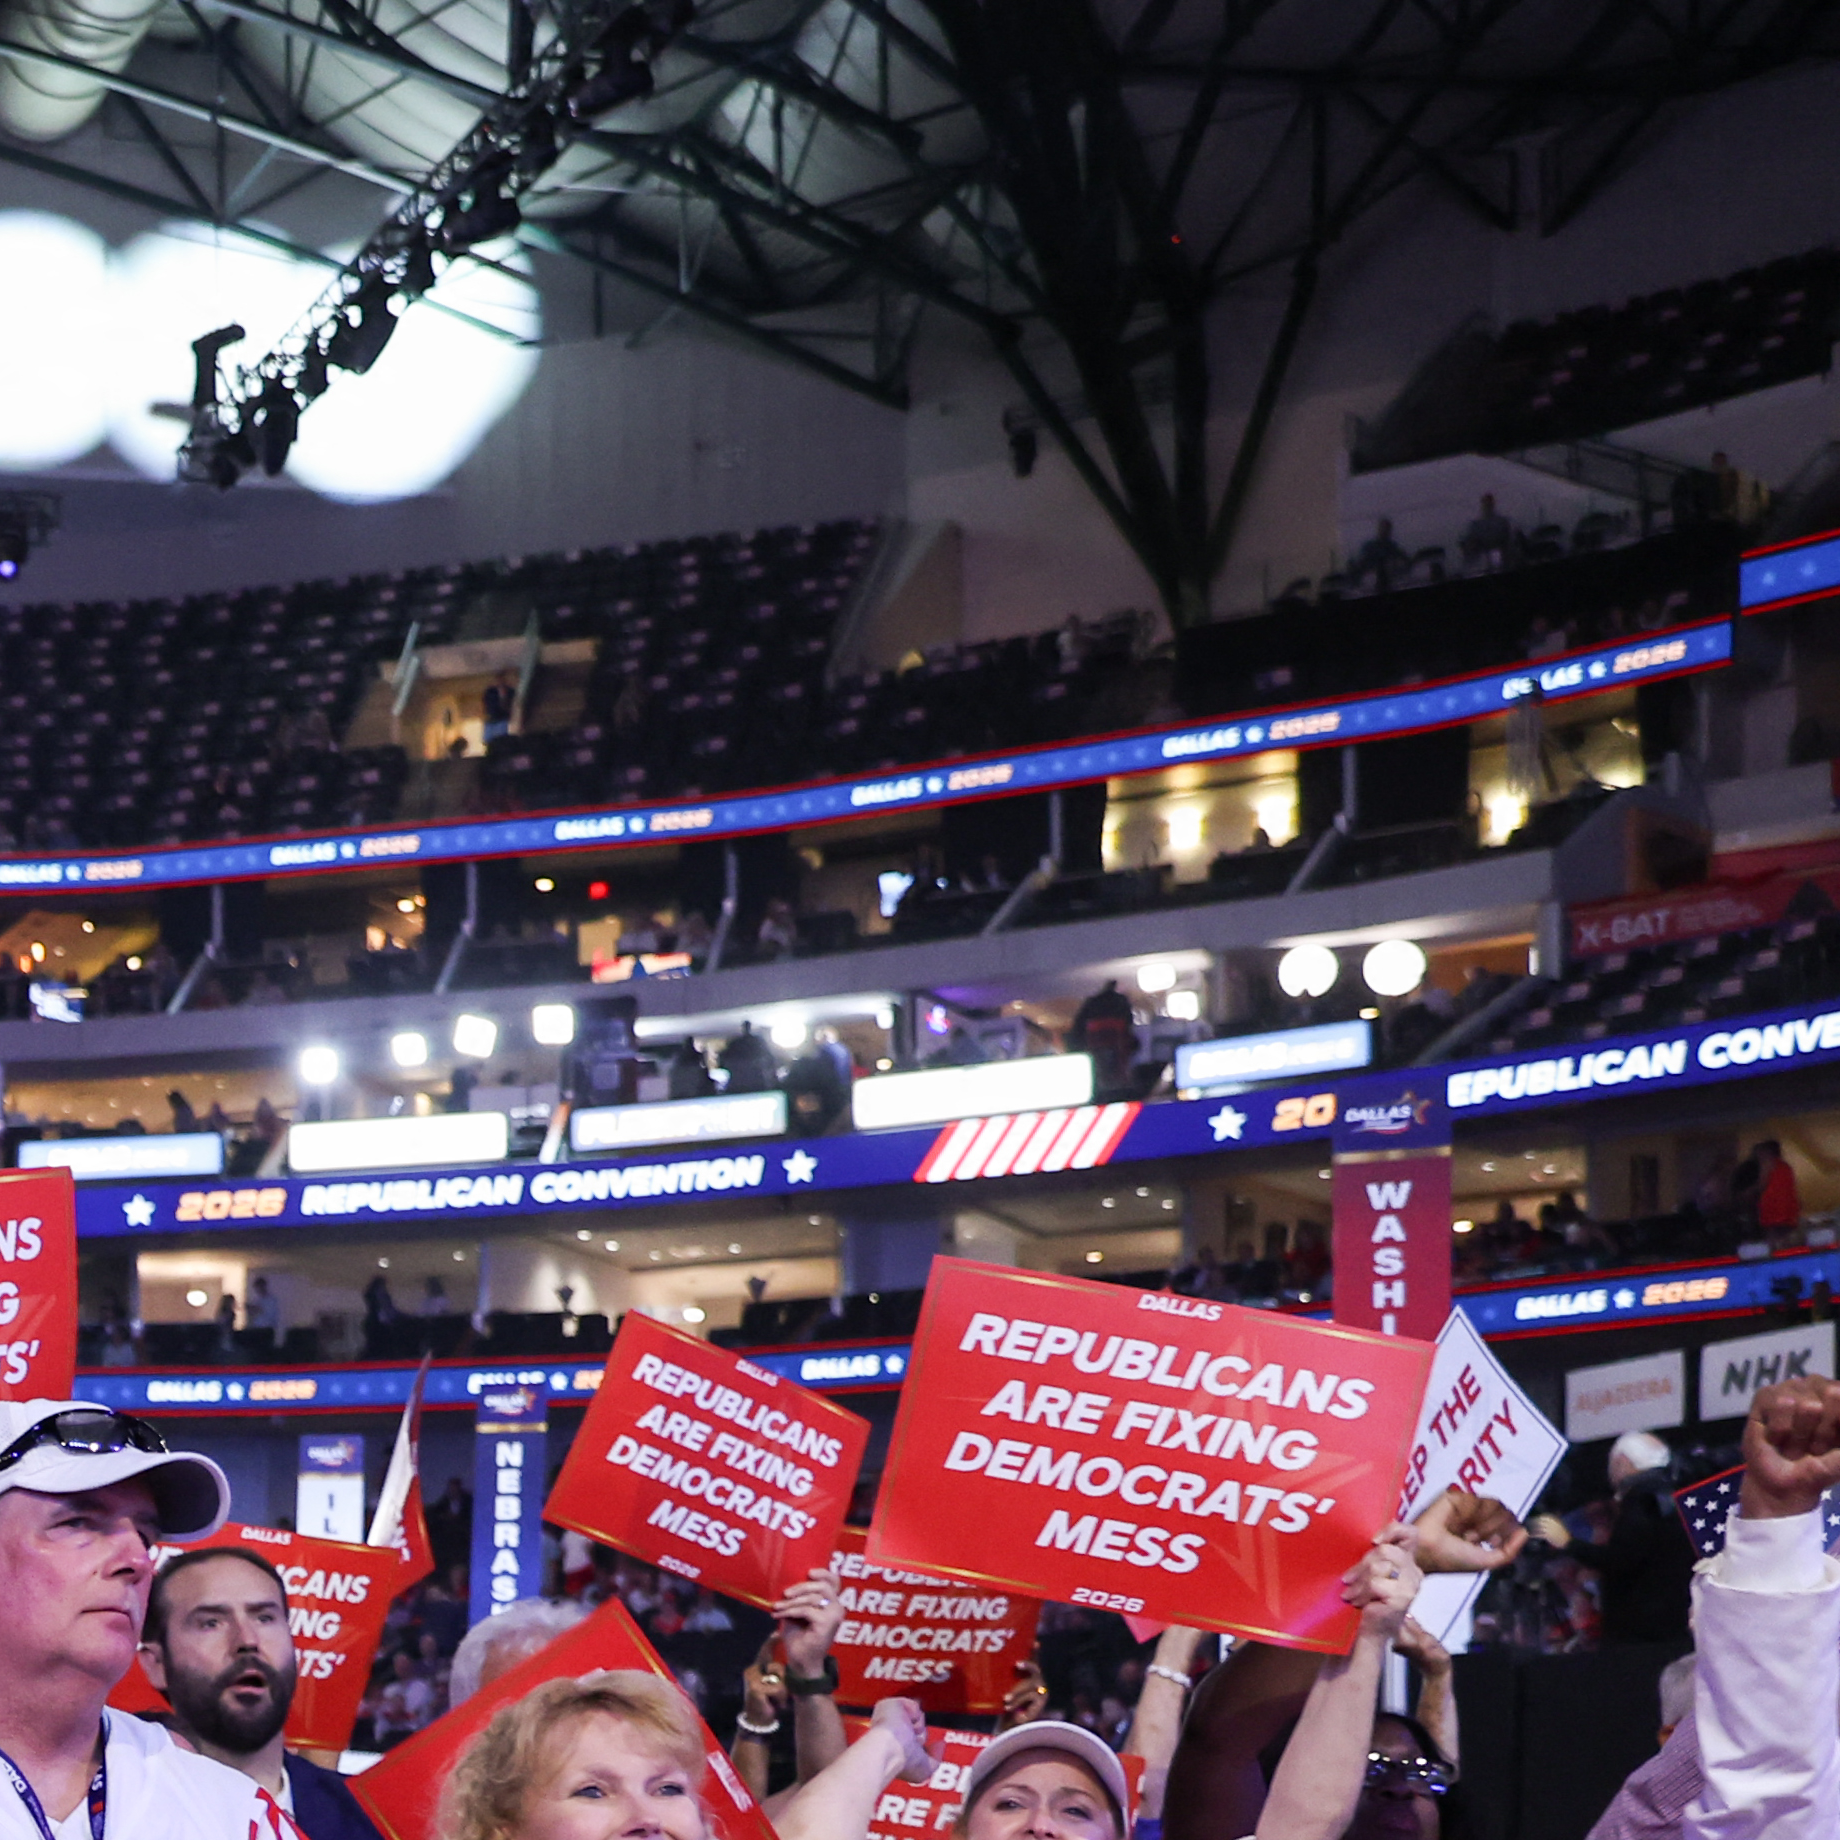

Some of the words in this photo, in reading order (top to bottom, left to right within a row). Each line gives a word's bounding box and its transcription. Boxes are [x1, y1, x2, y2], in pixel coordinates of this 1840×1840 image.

[1162, 723, 1241, 759] DALLAS
[553, 816, 626, 841] DALLAS
[269, 841, 338, 864] DALLAS
[1447, 1039, 1686, 1108] EPUBLICAN
[1272, 1094, 1336, 1131] 20
[177, 1188, 286, 1220] 2026
[302, 1174, 522, 1216] REPUBLICAN
[531, 1155, 764, 1202] CONVENTION
[1138, 1294, 1223, 1321] DALLAS
[1516, 1290, 1607, 1320] DALLAS
[735, 1358, 778, 1386] DALLAS
[959, 1312, 1376, 1421] REPUBLICANS
[1723, 1349, 1813, 1395] NHK
[146, 1379, 224, 1402] DALLAS
[1429, 1364, 1483, 1447] THE
[631, 1354, 842, 1468] REPUBLICANS
[981, 1379, 1106, 1433] ARE
[1113, 1402, 1318, 1470] FIXING
[636, 1404, 703, 1450] ARE
[708, 1430, 814, 1497] FIXING
[607, 1434, 817, 1539] DEMOCRATS'
[944, 1431, 1335, 1533] DEMOCRATS'
[241, 1526, 291, 1545] DALLAS
[646, 1500, 747, 1558] MESS
[1036, 1509, 1208, 1573] MESS
[837, 1589, 900, 1618] ARE
[905, 1591, 1008, 1622] FIXING
[1070, 1587, 1144, 1614] 2026
[833, 1621, 1014, 1652] EMOCRATS'
[864, 1656, 953, 1683] MESS
